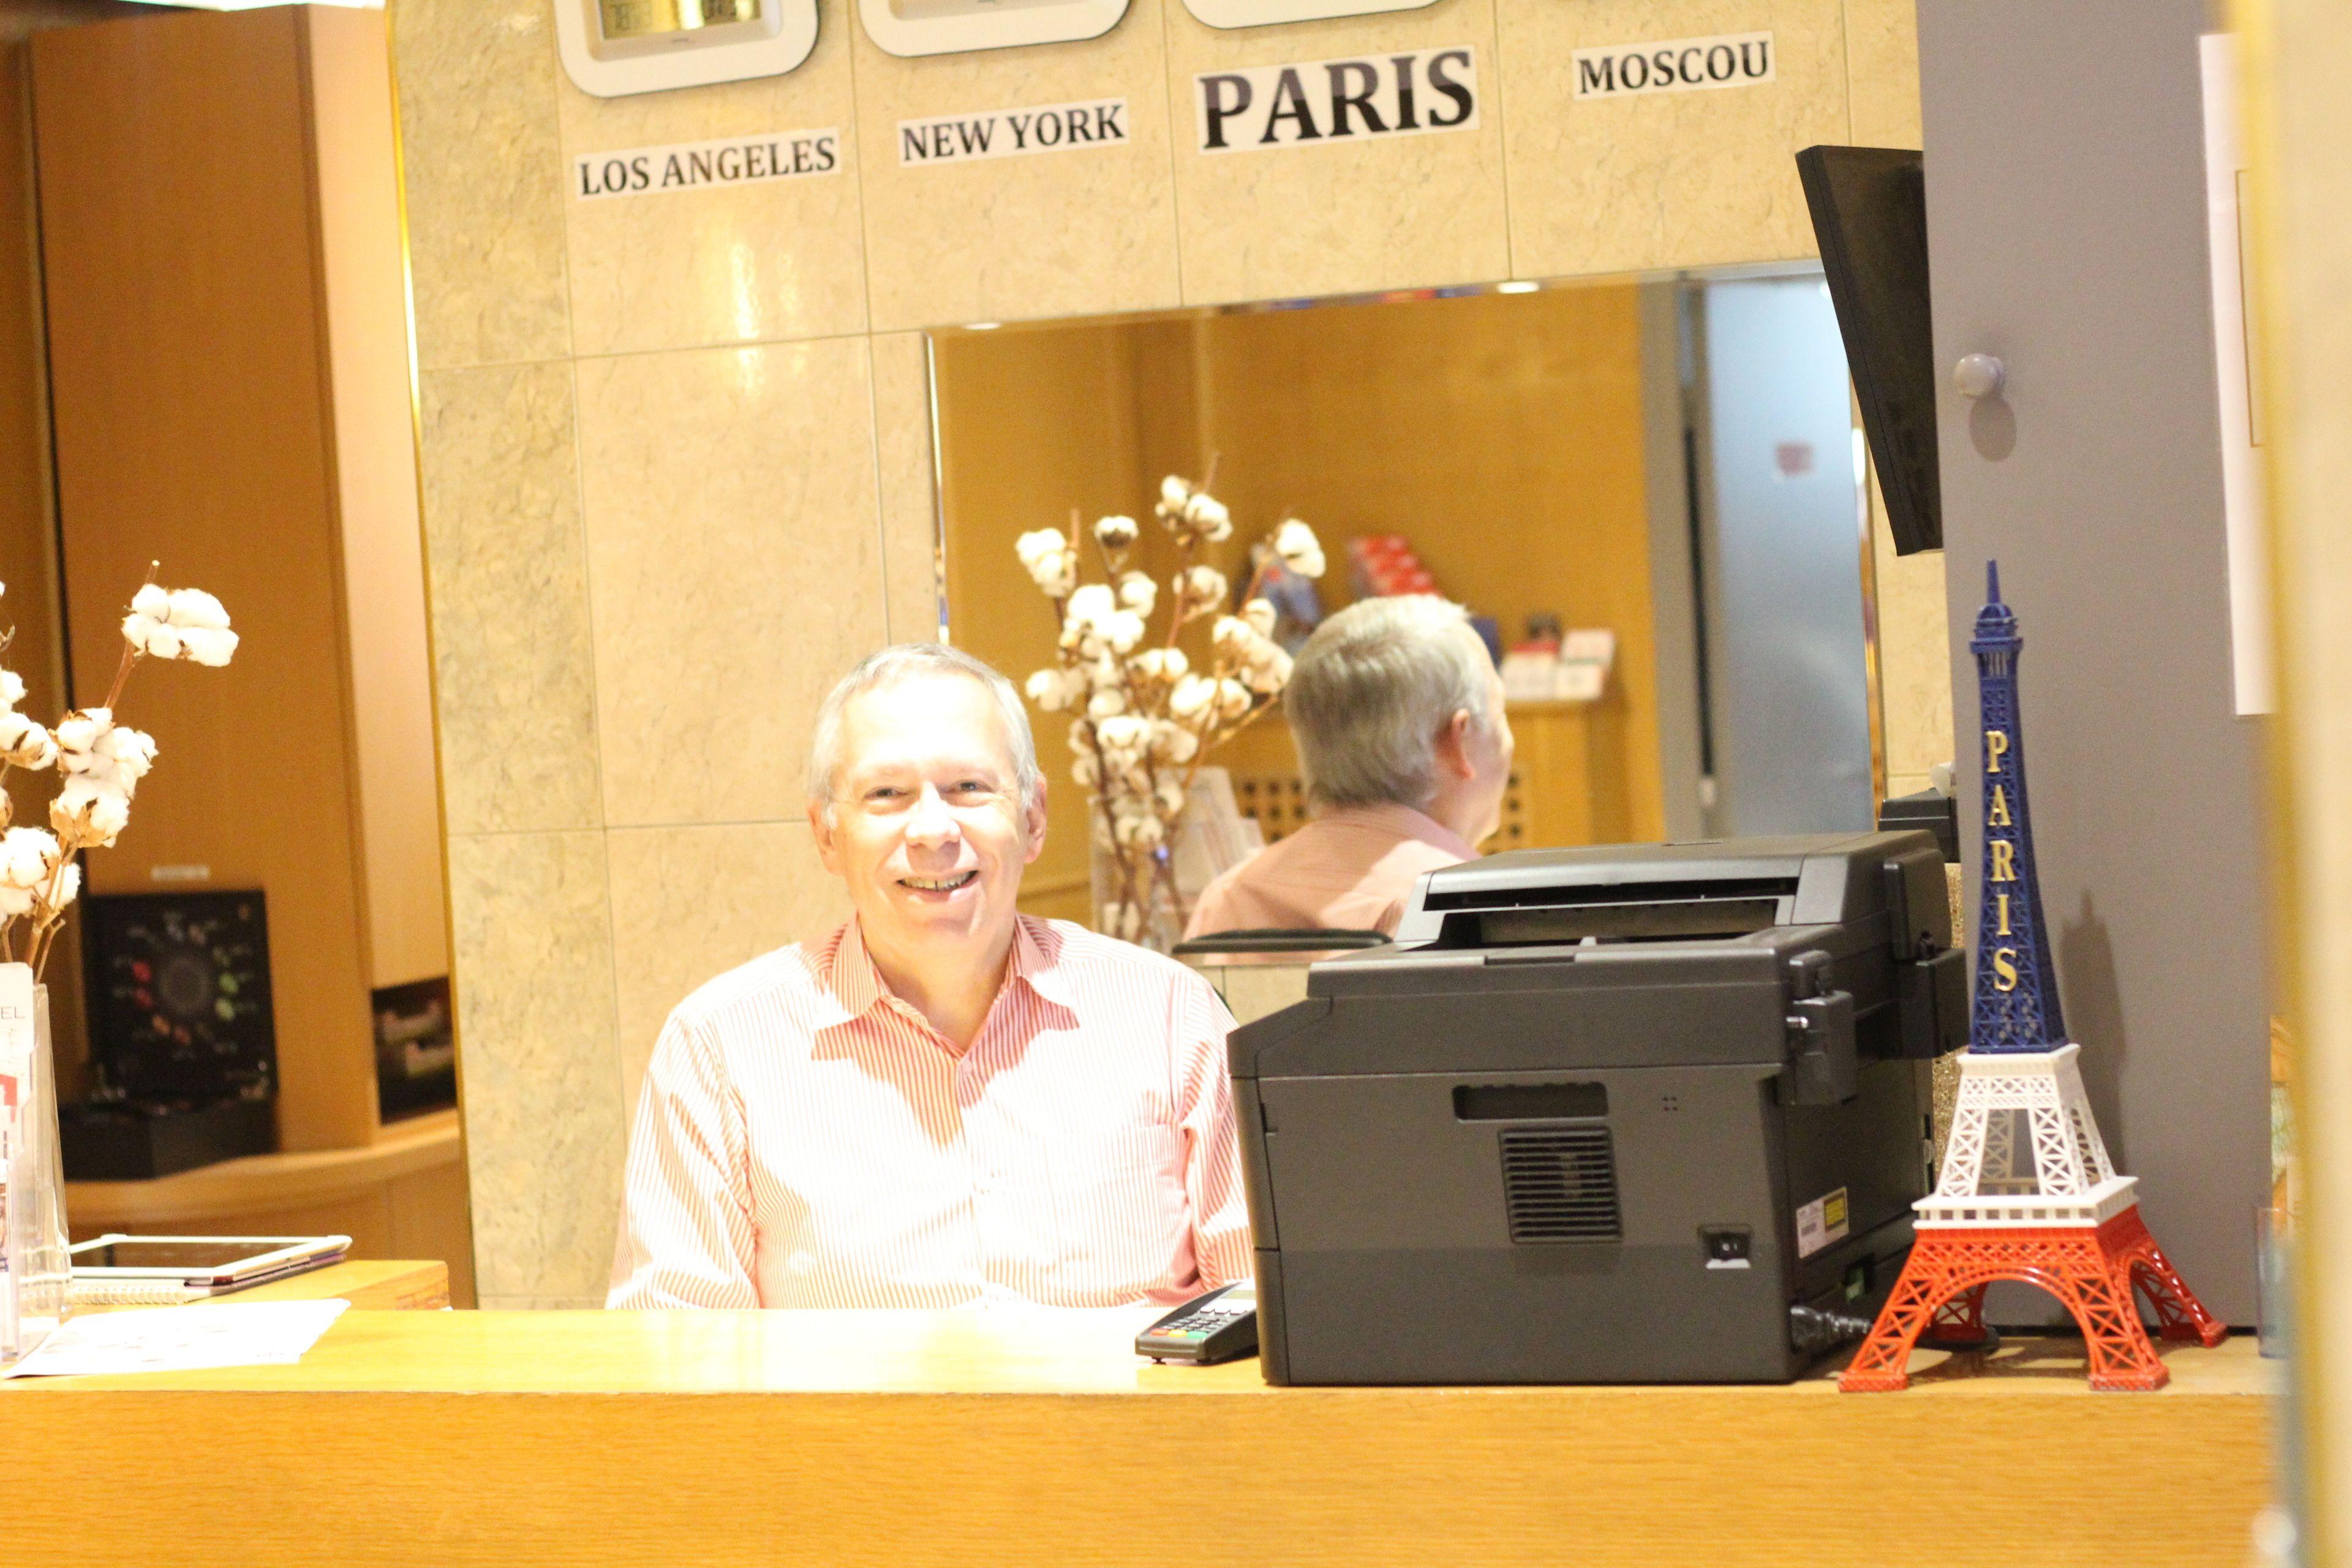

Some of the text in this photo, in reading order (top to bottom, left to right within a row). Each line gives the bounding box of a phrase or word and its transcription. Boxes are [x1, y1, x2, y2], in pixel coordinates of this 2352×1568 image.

[1578, 40, 1769, 95] MOSCOU
[1198, 50, 1473, 149] PARIS
[902, 104, 1125, 162] NEW YORK
[579, 137, 836, 196] LOS ANGELES
[1985, 730, 2018, 992] PARIS
